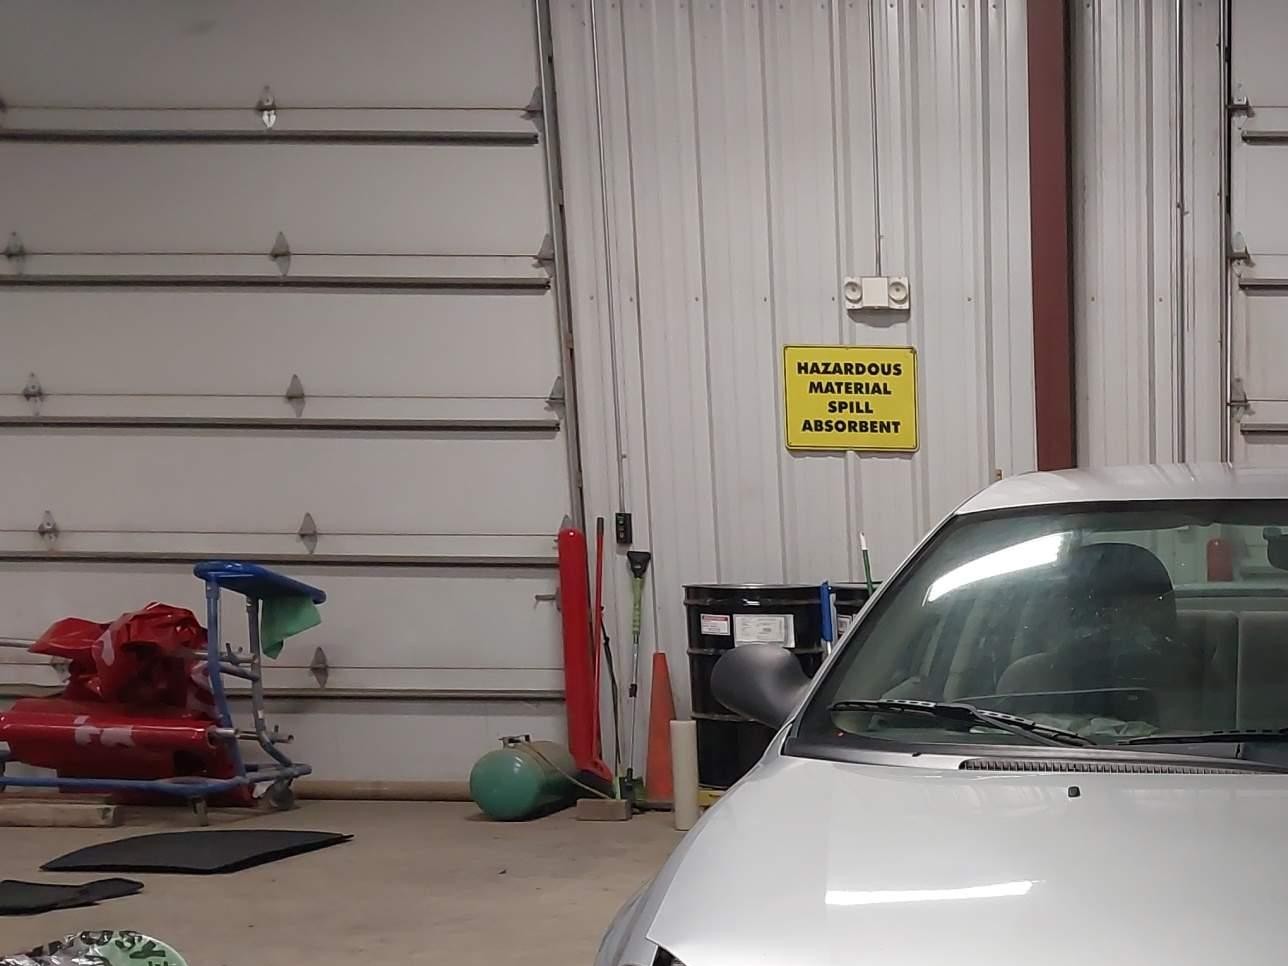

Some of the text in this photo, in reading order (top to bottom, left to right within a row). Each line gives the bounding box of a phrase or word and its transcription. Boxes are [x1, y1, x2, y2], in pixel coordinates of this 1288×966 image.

[797, 362, 902, 376] HAZARDOUS
[808, 381, 892, 395] MATERIAL
[828, 401, 874, 414] SPILL
[801, 419, 901, 434] ABSORBENT
